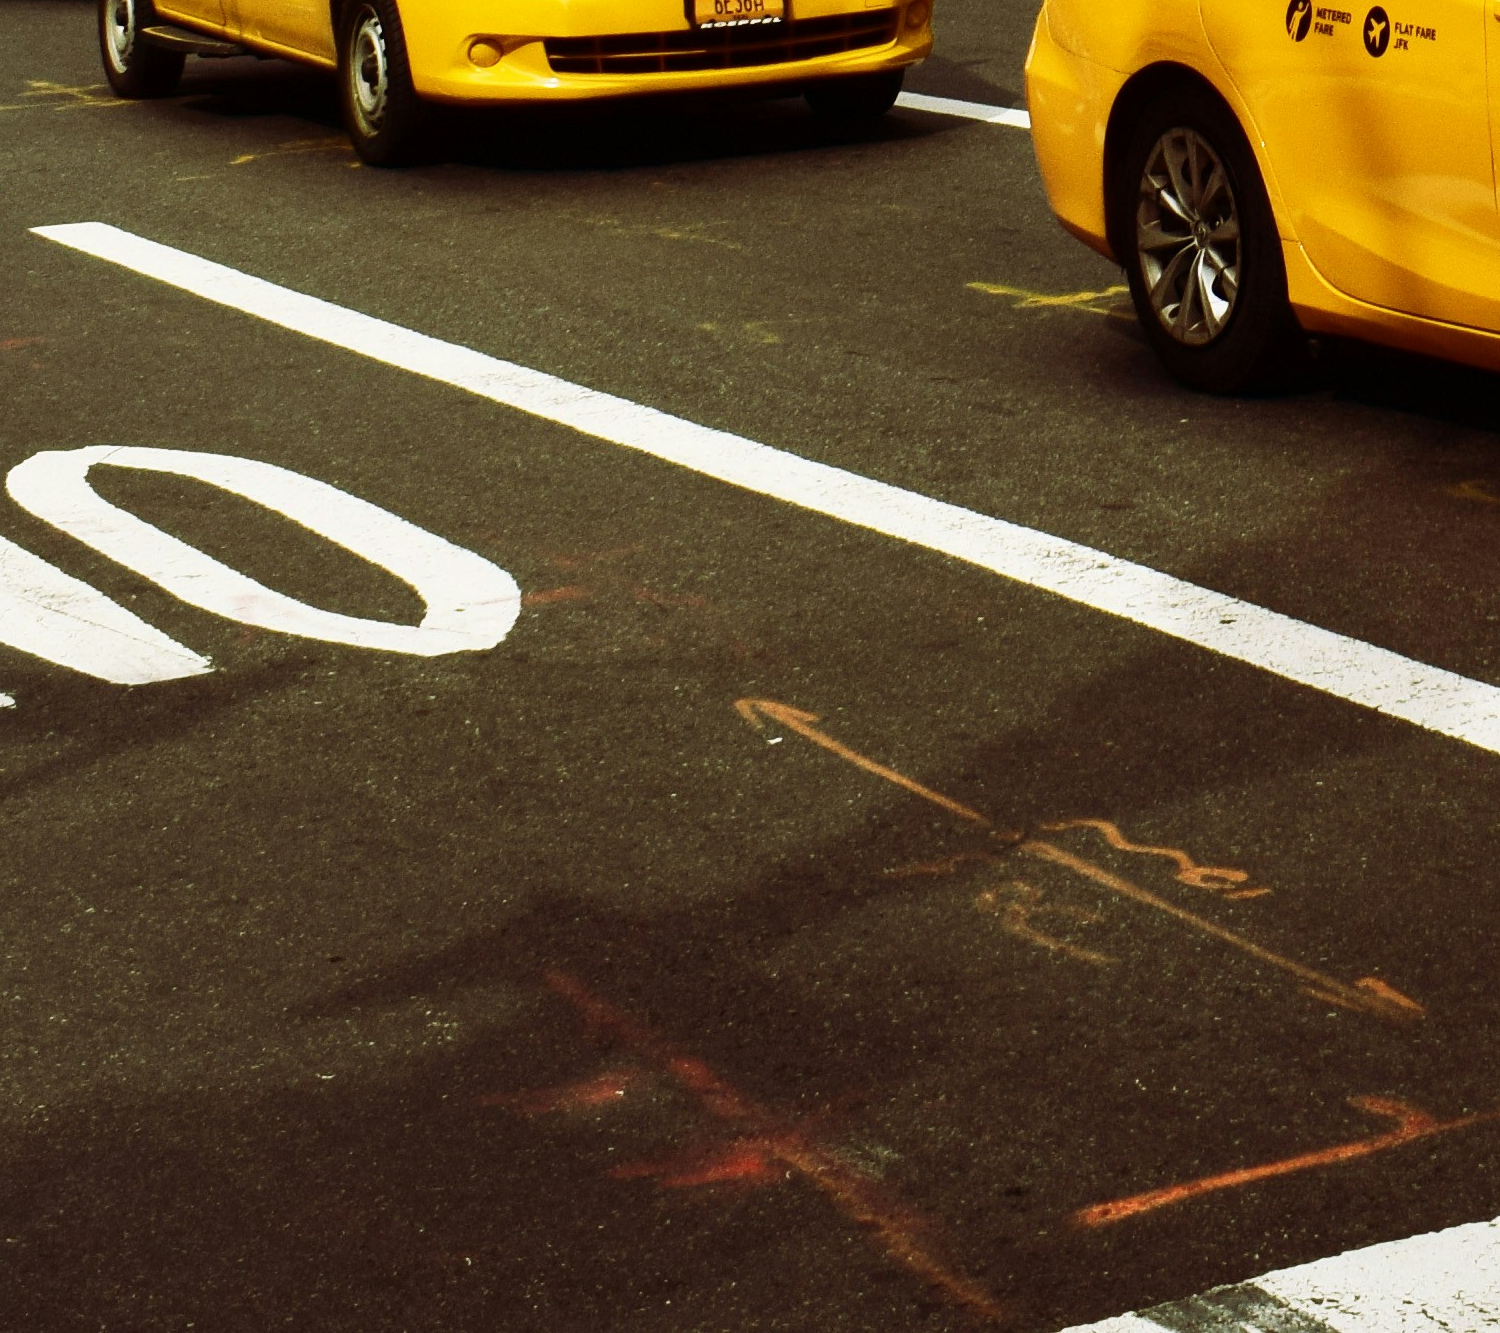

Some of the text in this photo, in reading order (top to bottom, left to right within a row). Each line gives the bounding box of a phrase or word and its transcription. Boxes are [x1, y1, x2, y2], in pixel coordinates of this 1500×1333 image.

[1316, 7, 1352, 24] METERED
[1314, 22, 1334, 36] FARE
[1395, 22, 1437, 41] FLAT FARE
[1394, 38, 1409, 50] JFK
